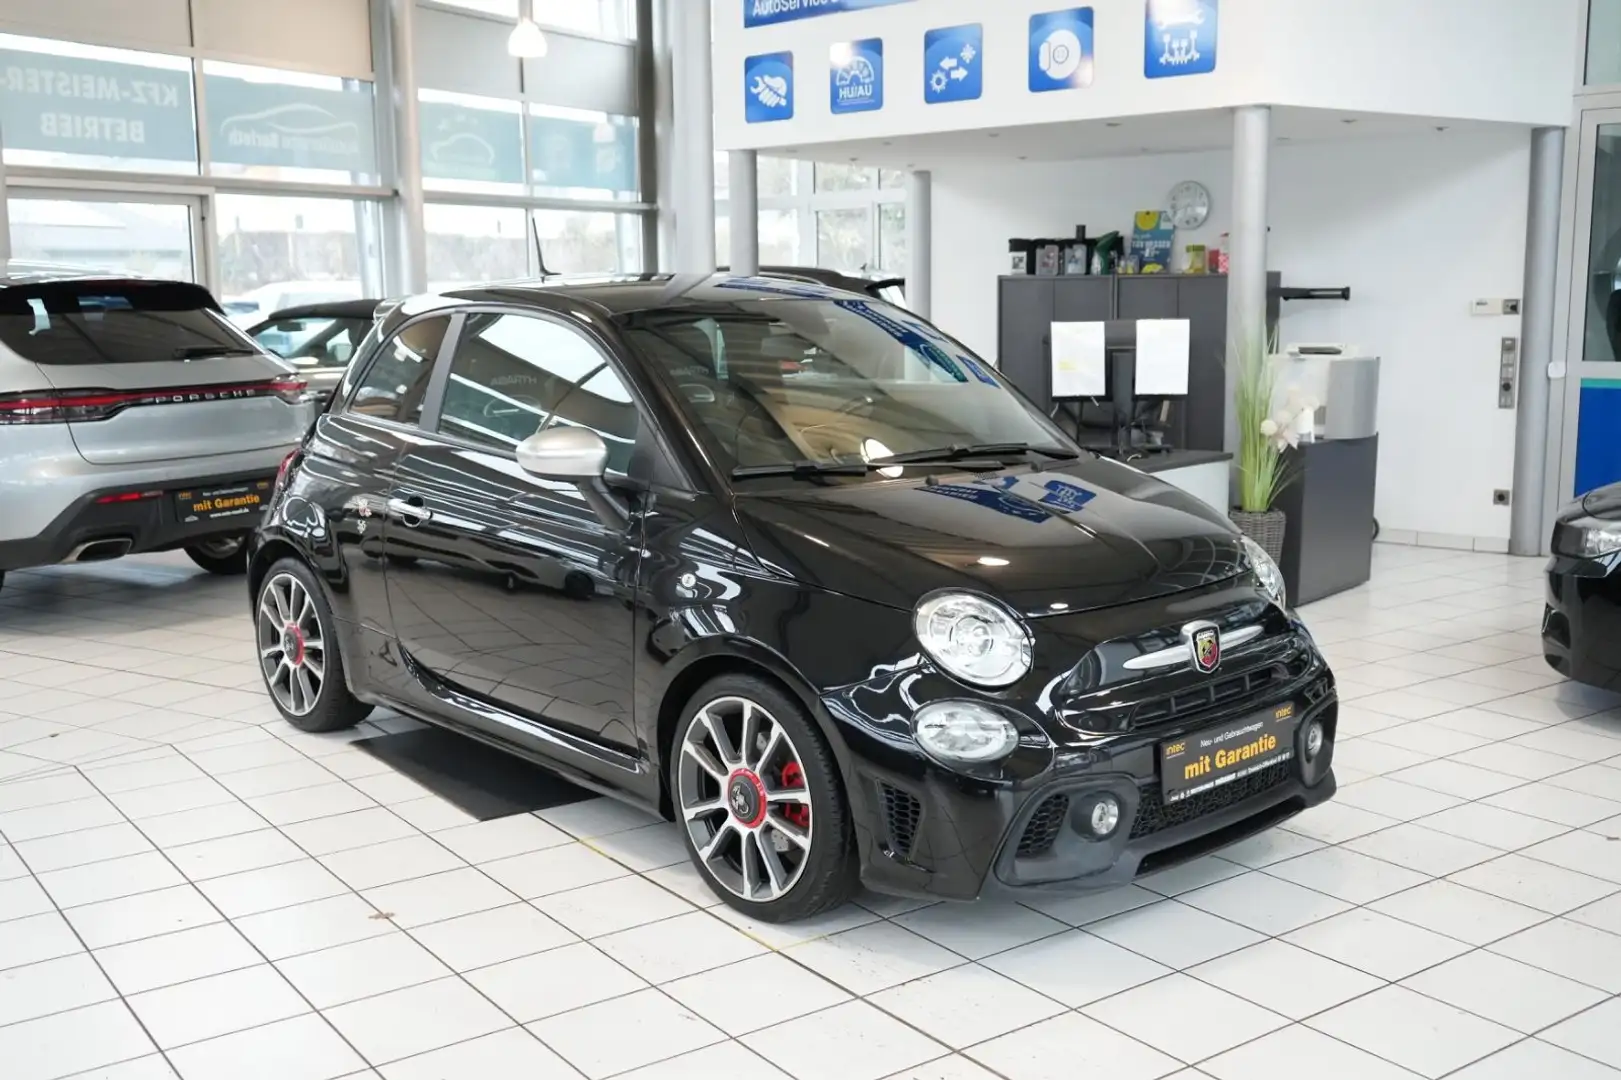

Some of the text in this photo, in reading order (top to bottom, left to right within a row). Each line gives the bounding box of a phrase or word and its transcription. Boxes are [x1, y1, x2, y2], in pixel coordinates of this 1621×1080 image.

[155, 389, 255, 404] PORSCHE
[1184, 755, 1211, 780] mit
[1215, 733, 1277, 769] Garantie
